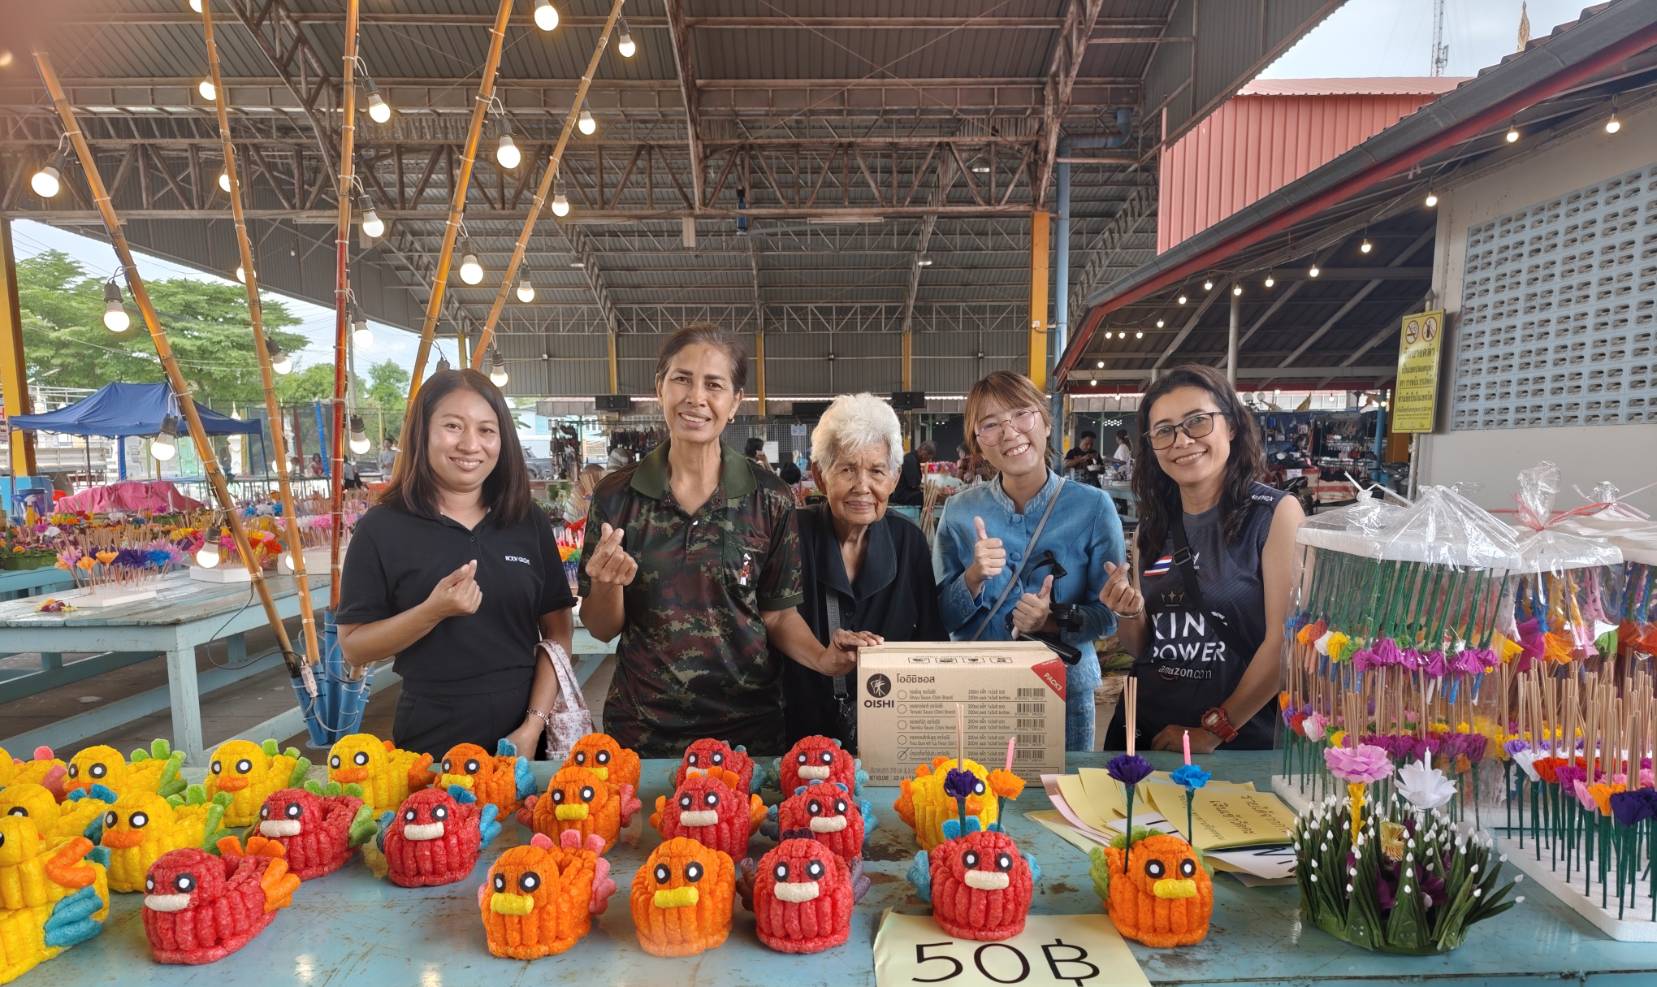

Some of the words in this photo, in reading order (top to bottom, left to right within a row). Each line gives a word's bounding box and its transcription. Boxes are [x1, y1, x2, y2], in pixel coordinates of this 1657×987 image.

[1152, 611, 1228, 640] KIN
[1158, 664, 1212, 679] amazon.com
[896, 673, 936, 684] โออิชิซอส
[863, 700, 894, 708] OISHI
